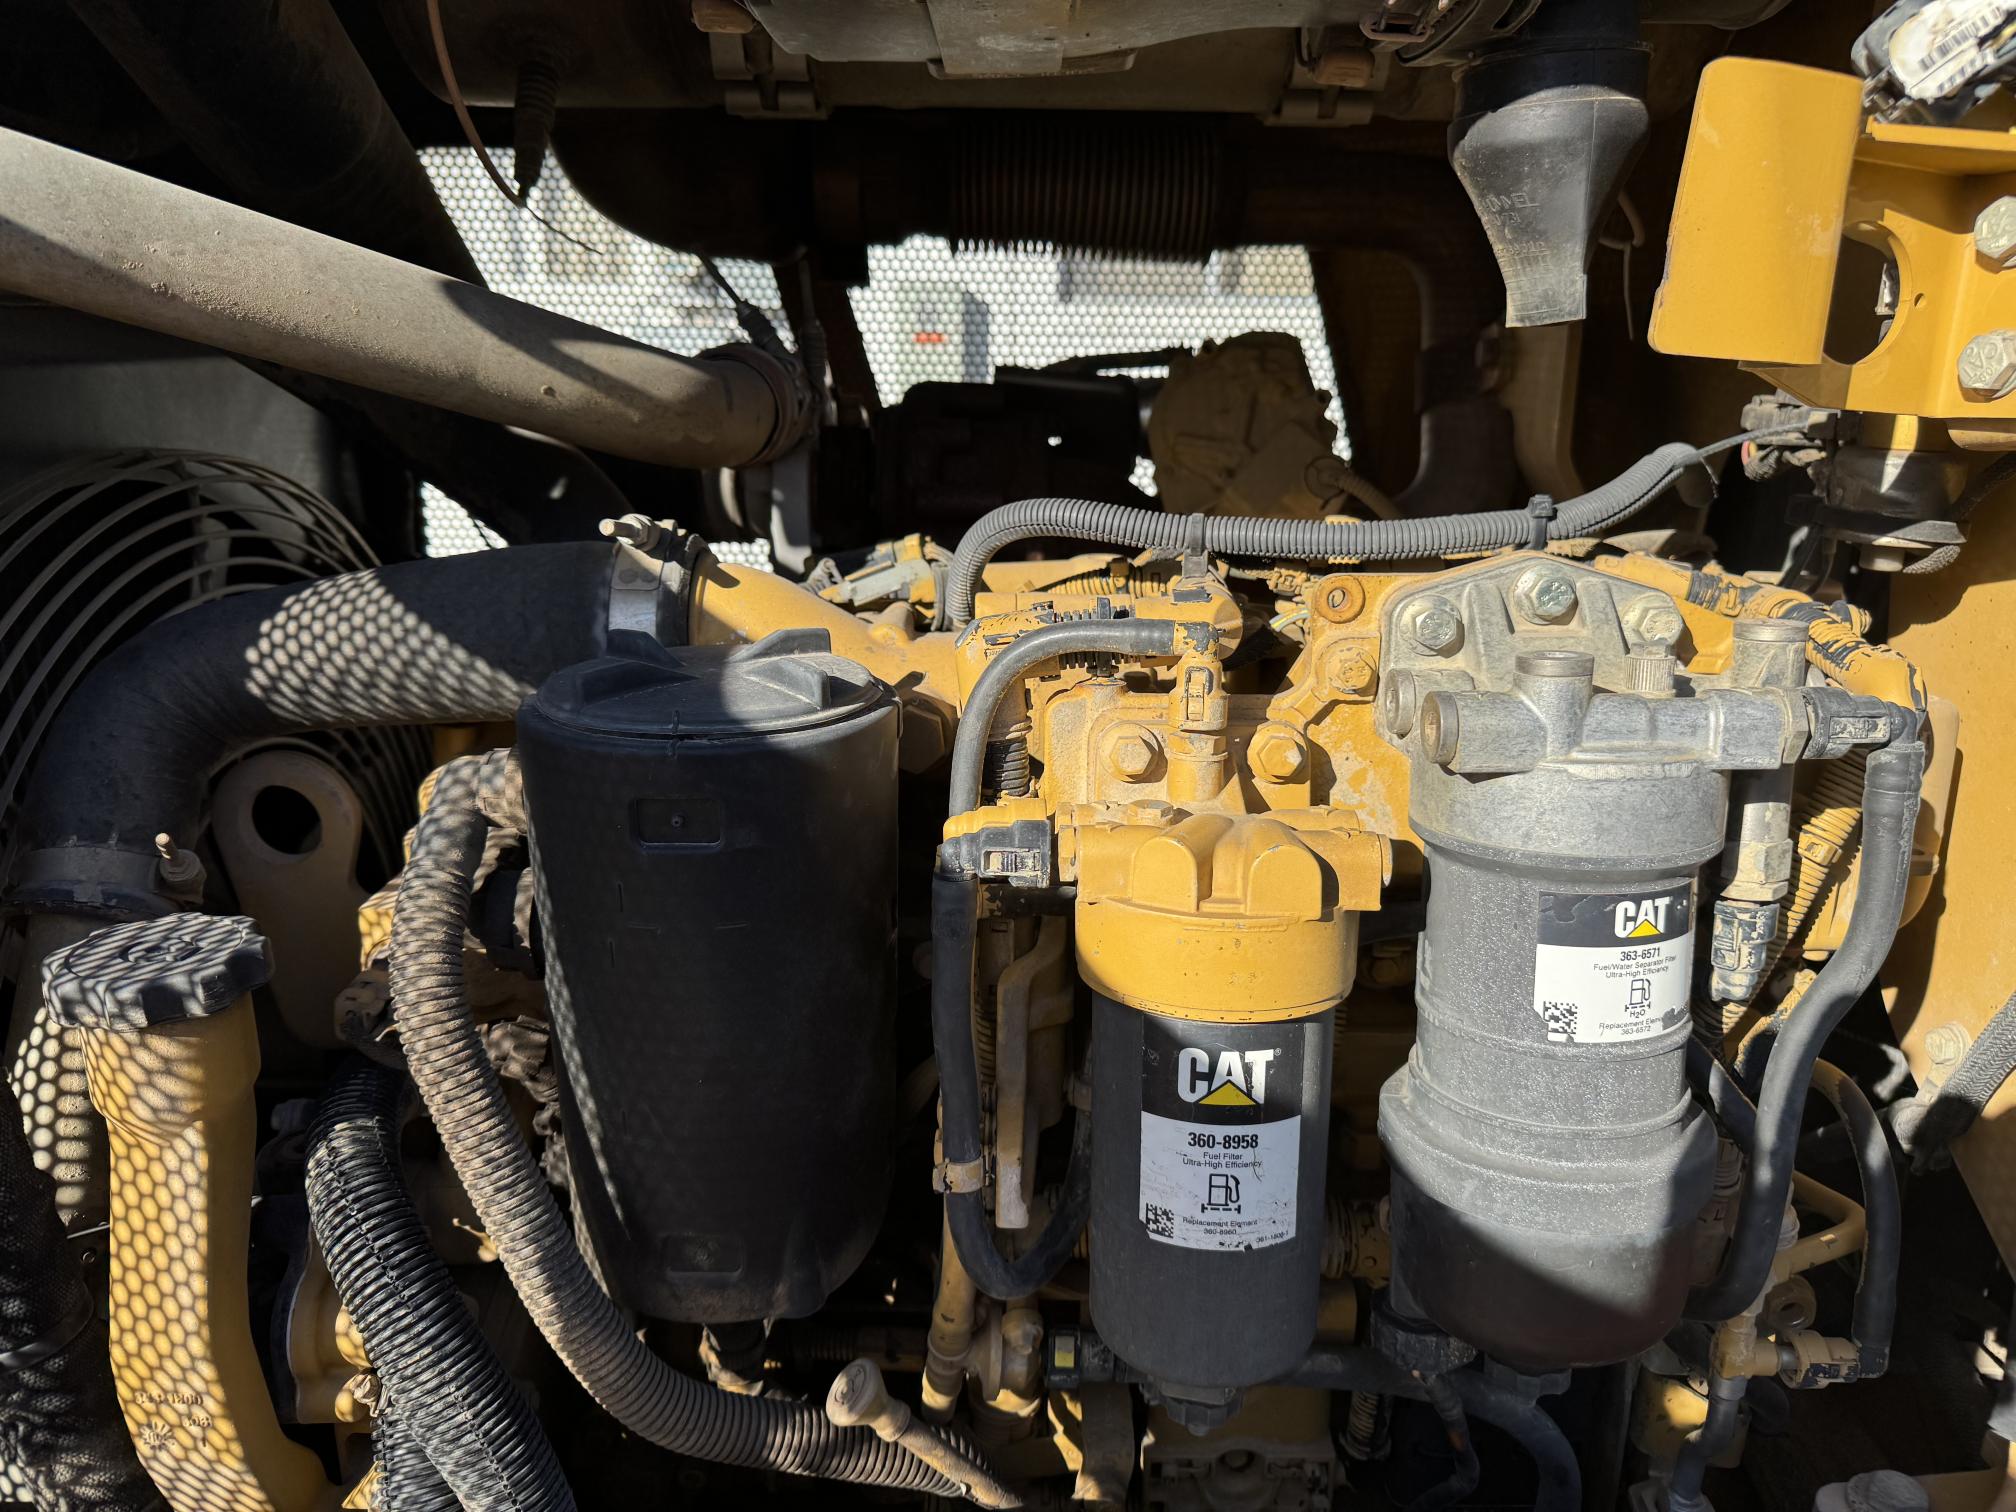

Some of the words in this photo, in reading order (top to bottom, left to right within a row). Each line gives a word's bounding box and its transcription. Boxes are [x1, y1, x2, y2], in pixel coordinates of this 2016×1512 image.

[1615, 896, 1670, 938] CAT
[1620, 947, 1660, 961] 363-6571
[1635, 958, 1664, 969] Separator
[1665, 954, 1677, 962] Filter
[1606, 970, 1641, 978] Ultra-High
[1642, 966, 1669, 976] Efficiency
[1599, 1020, 1644, 1030] Replacement
[1621, 1026, 1651, 1035] 363-6572
[1178, 1048, 1274, 1104] CAT
[1188, 1132, 1259, 1149] 360-8958
[1203, 1152, 1221, 1160] Fuel
[1223, 1153, 1243, 1161] Filter
[1183, 1157, 1223, 1169] Ultra-High
[1225, 1160, 1262, 1168] Efficiency
[1183, 1217, 1229, 1227] Replacement
[1204, 1228, 1237, 1236] 360-8960
